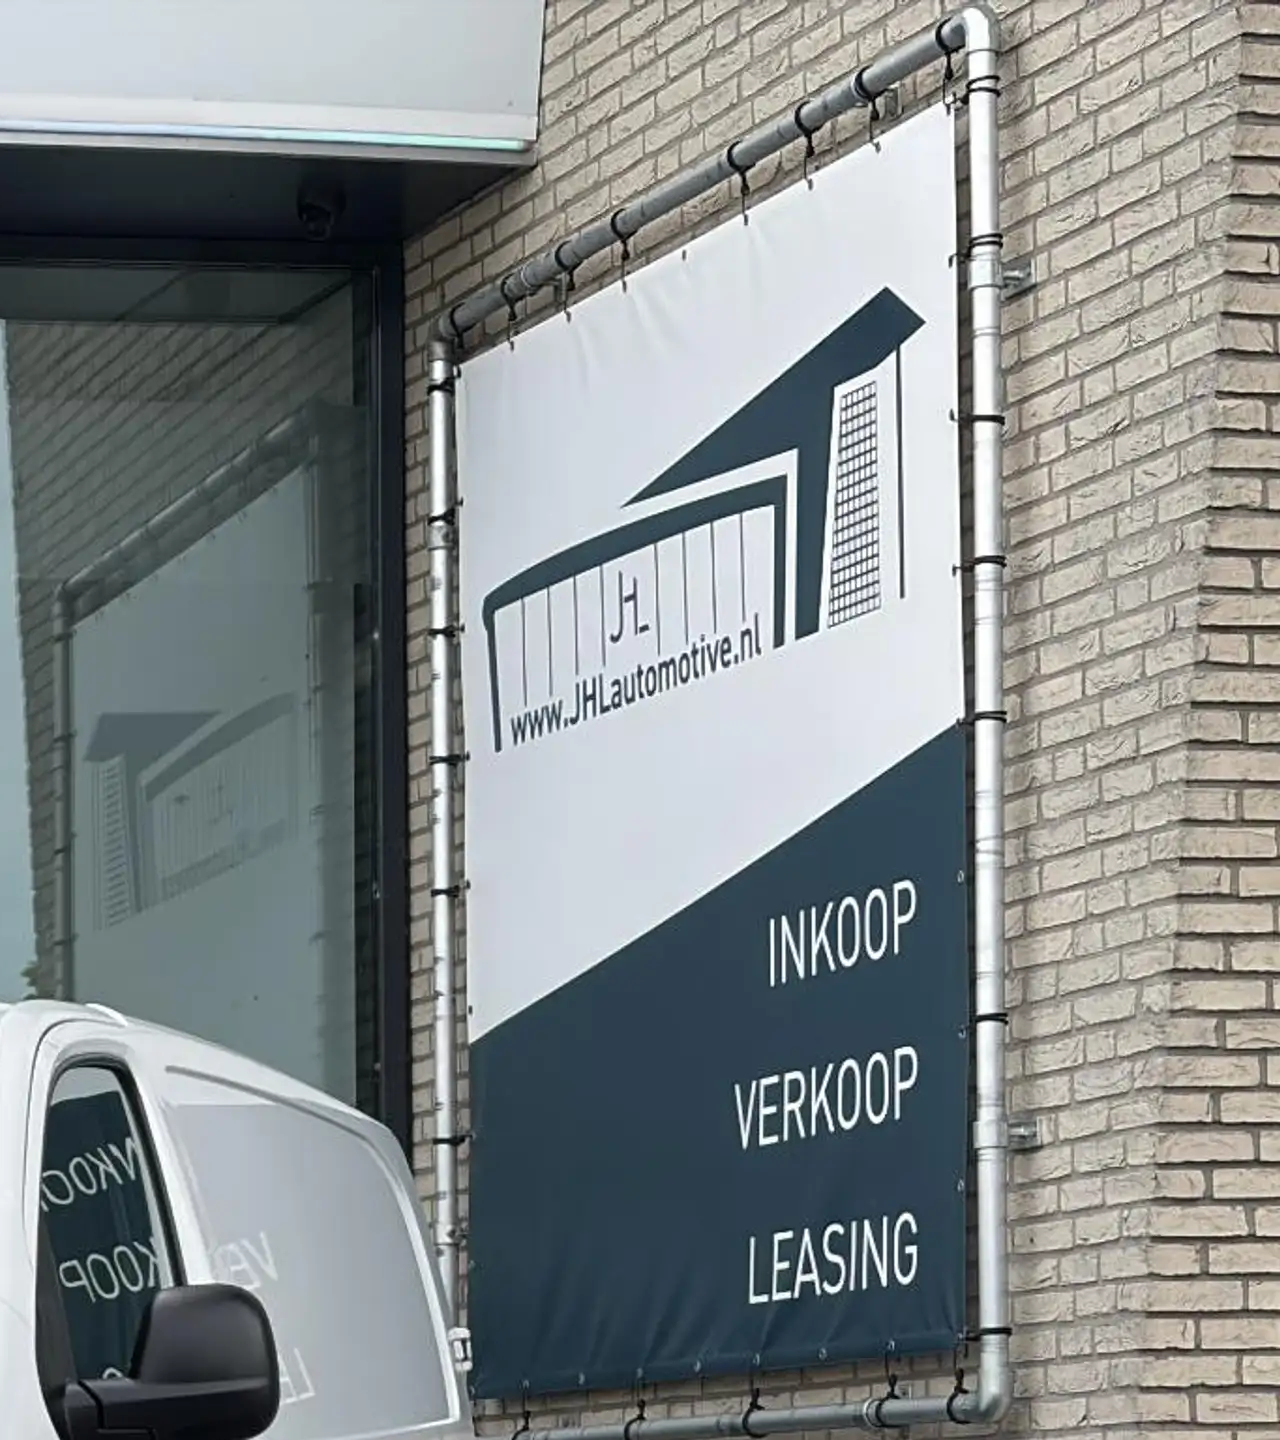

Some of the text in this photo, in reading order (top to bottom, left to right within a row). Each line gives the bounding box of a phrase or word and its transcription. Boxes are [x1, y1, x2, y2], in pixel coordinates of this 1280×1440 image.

[510, 612, 762, 747] www.JHLautomotive.nl
[769, 879, 917, 987] INKOOP
[735, 1045, 918, 1151] VERKOOP
[748, 1211, 918, 1305] LEASING
